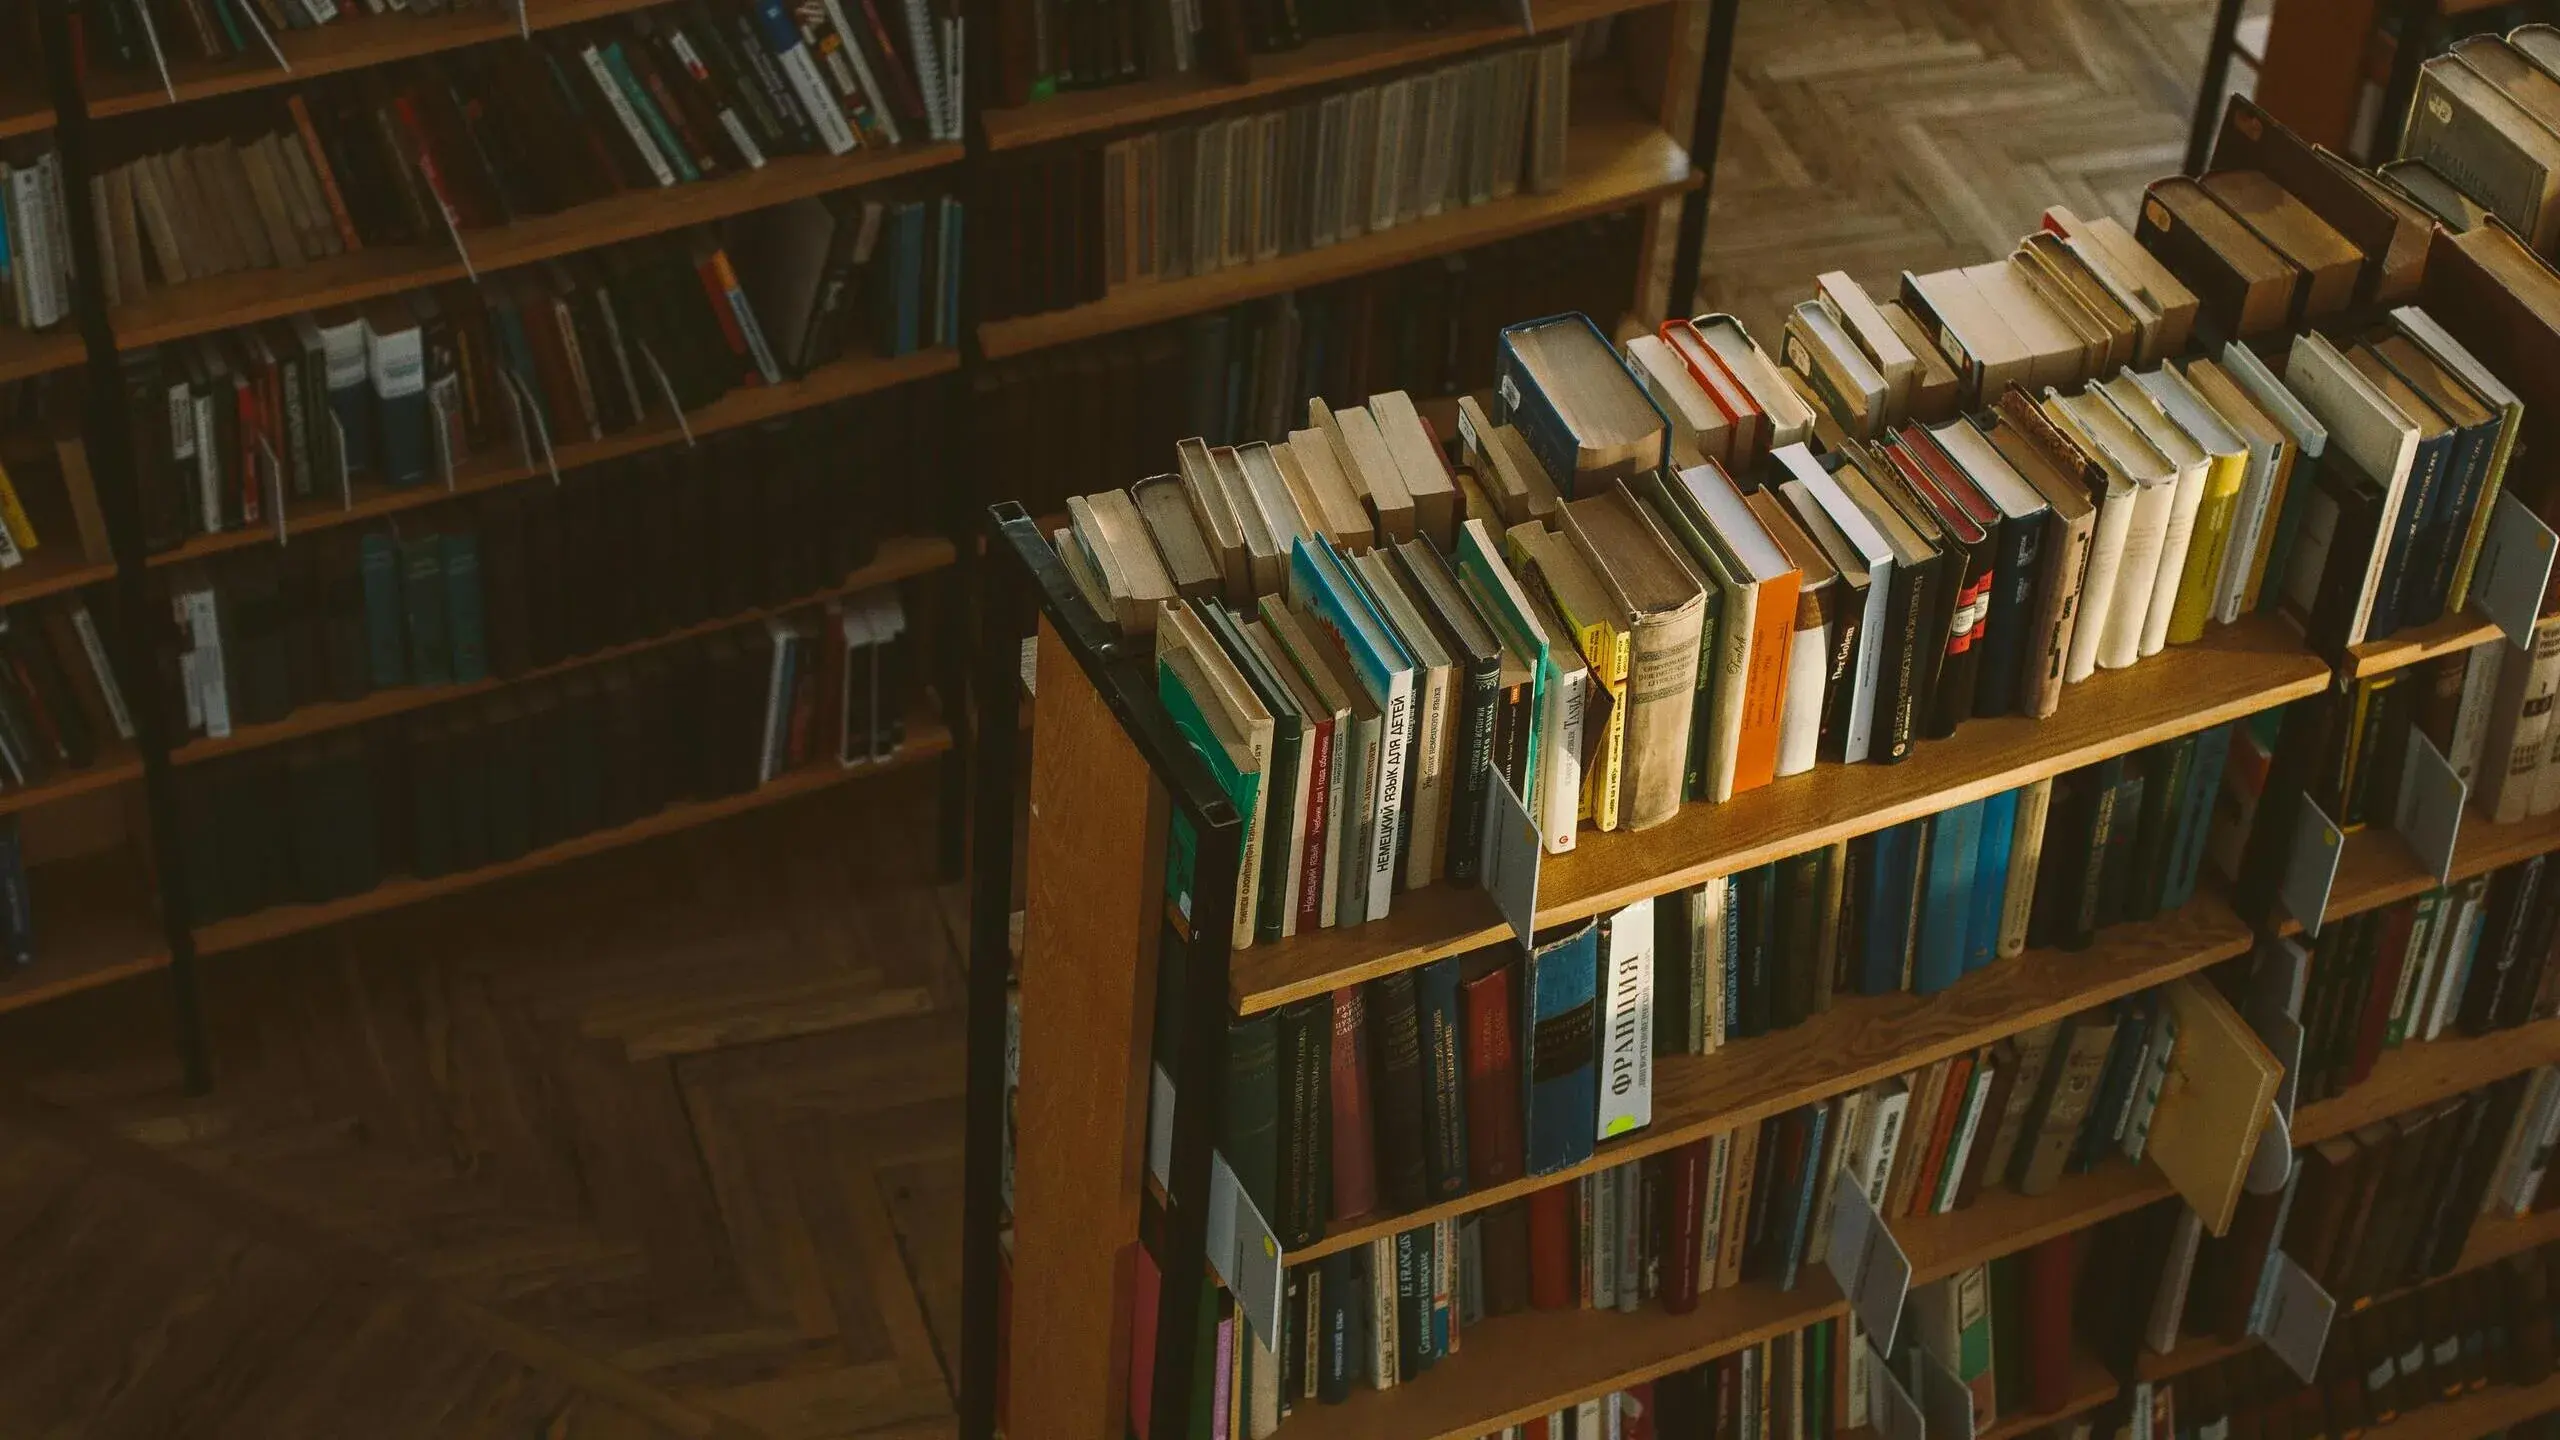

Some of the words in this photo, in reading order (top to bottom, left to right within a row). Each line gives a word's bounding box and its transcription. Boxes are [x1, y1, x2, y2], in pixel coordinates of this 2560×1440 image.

[1830, 659, 1845, 681] Der
[1838, 624, 1854, 660] Golem
[1389, 694, 1404, 735] ДЕТЕЙ
[1432, 686, 1440, 710] языка
[1388, 737, 1401, 764] ДЛЯ
[1428, 712, 1438, 753] немецкого
[1385, 766, 1397, 803] ЯЗЫК
[1423, 754, 1433, 789] Учебник
[1376, 804, 1394, 872] НЕМЕЦКИЙ
[1610, 953, 1640, 1095] ФРАНЦИЯ
[1398, 1233, 1413, 1281] FRANÇAIS
[1417, 1250, 1430, 1298] française
[1400, 1282, 1413, 1297] LE
[1416, 1297, 1432, 1354] Grammaire
